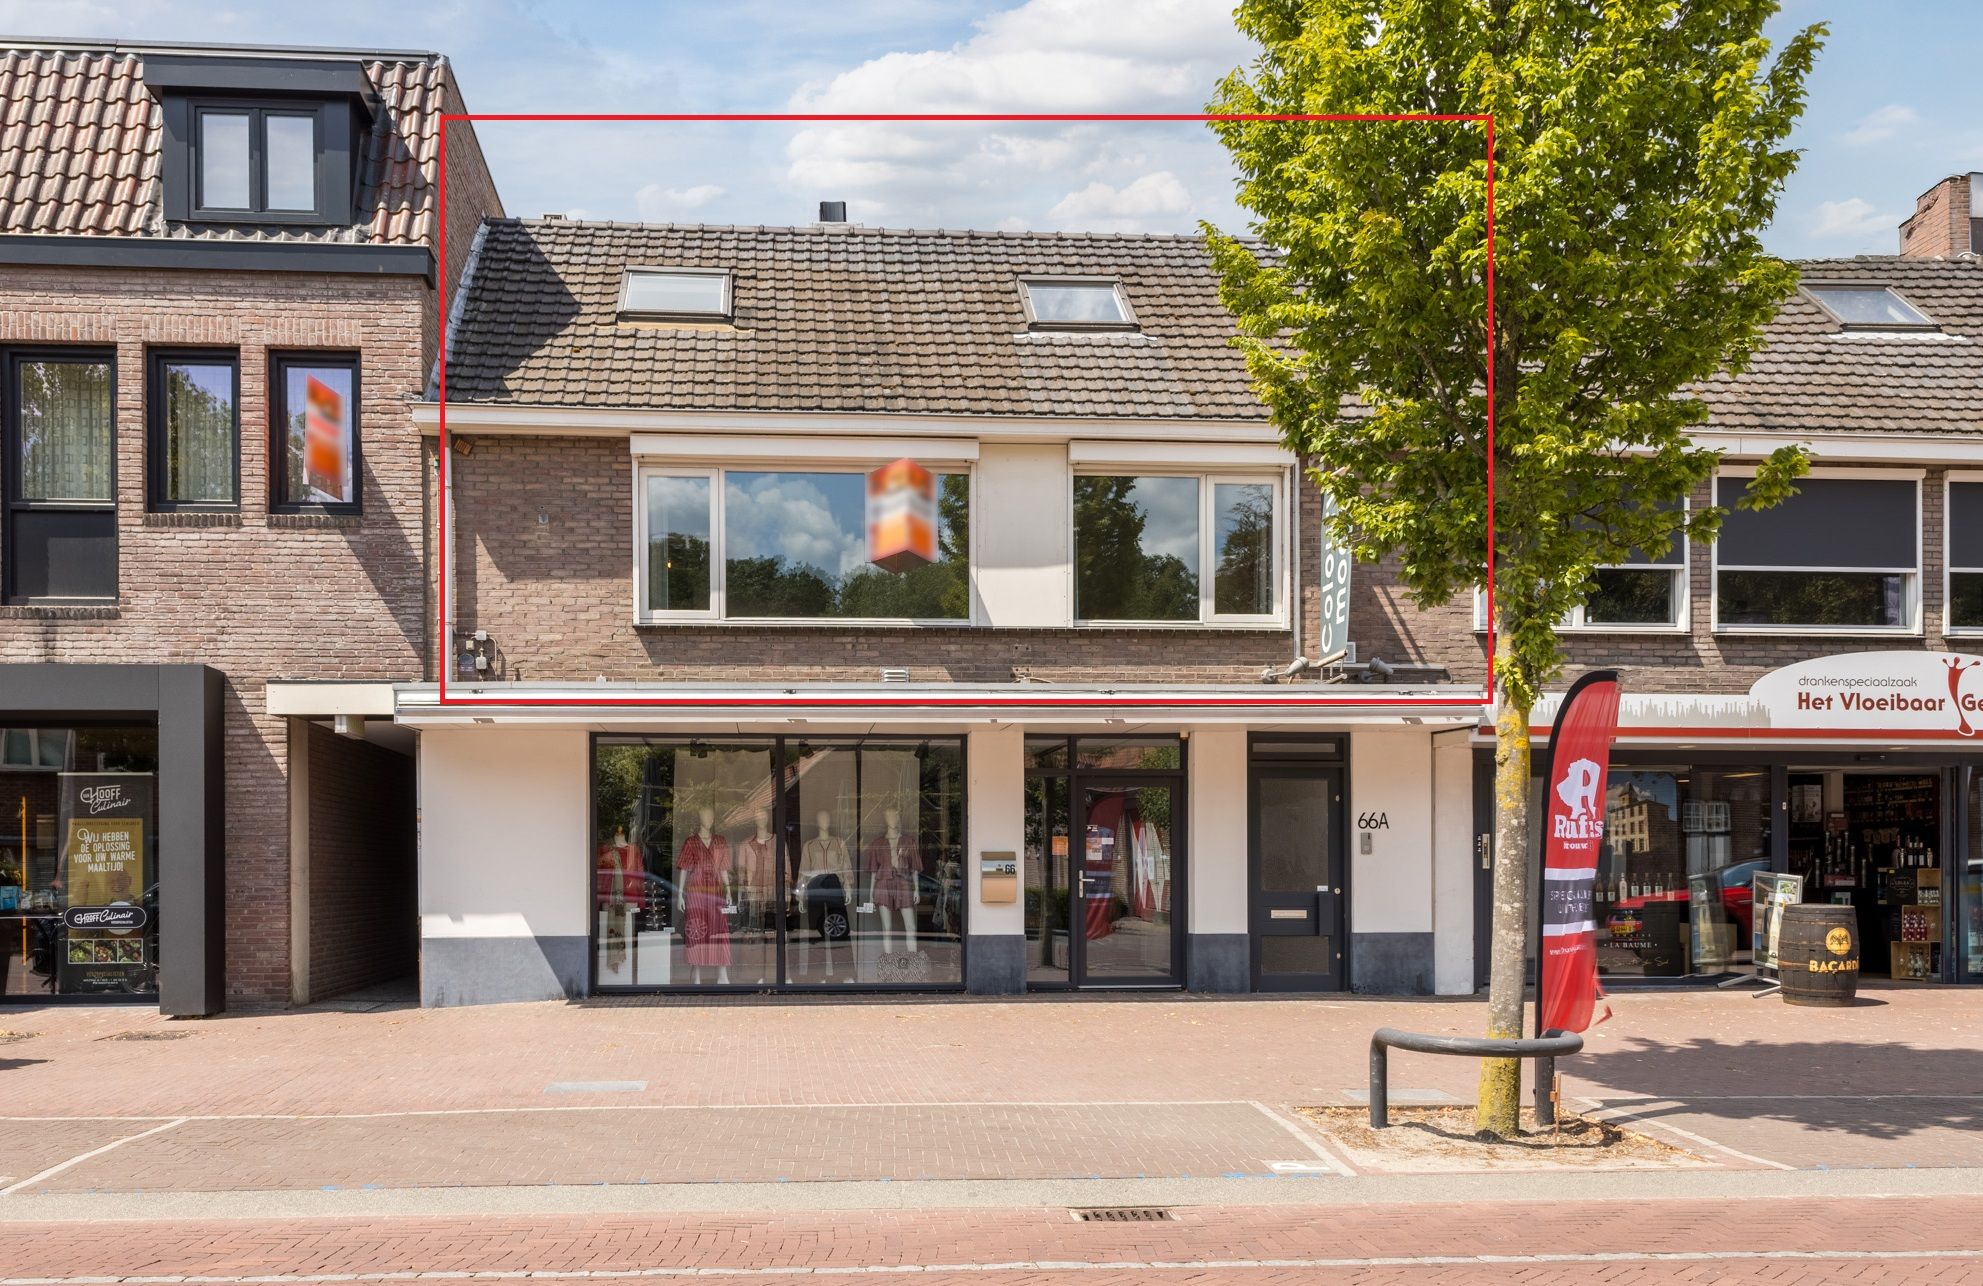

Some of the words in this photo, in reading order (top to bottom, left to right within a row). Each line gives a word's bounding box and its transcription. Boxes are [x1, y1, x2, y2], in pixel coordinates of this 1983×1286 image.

[1798, 676, 1918, 689] drankenspeciaalzaak
[1797, 692, 1833, 710] Het
[1840, 692, 1946, 712] Vloeibaar
[90, 798, 131, 814] Culinair
[1357, 812, 1390, 830] 66A
[78, 828, 100, 843] WIJ
[102, 831, 130, 842] HEBBEN
[80, 843, 90, 853] DE
[93, 841, 131, 853] OPLOSSING
[73, 854, 93, 864] VOOR
[95, 852, 107, 863] UW
[110, 850, 136, 862] WARME
[87, 861, 124, 873] MAALTIJD!
[1004, 863, 1016, 875] 66
[100, 909, 134, 923] Culinair
